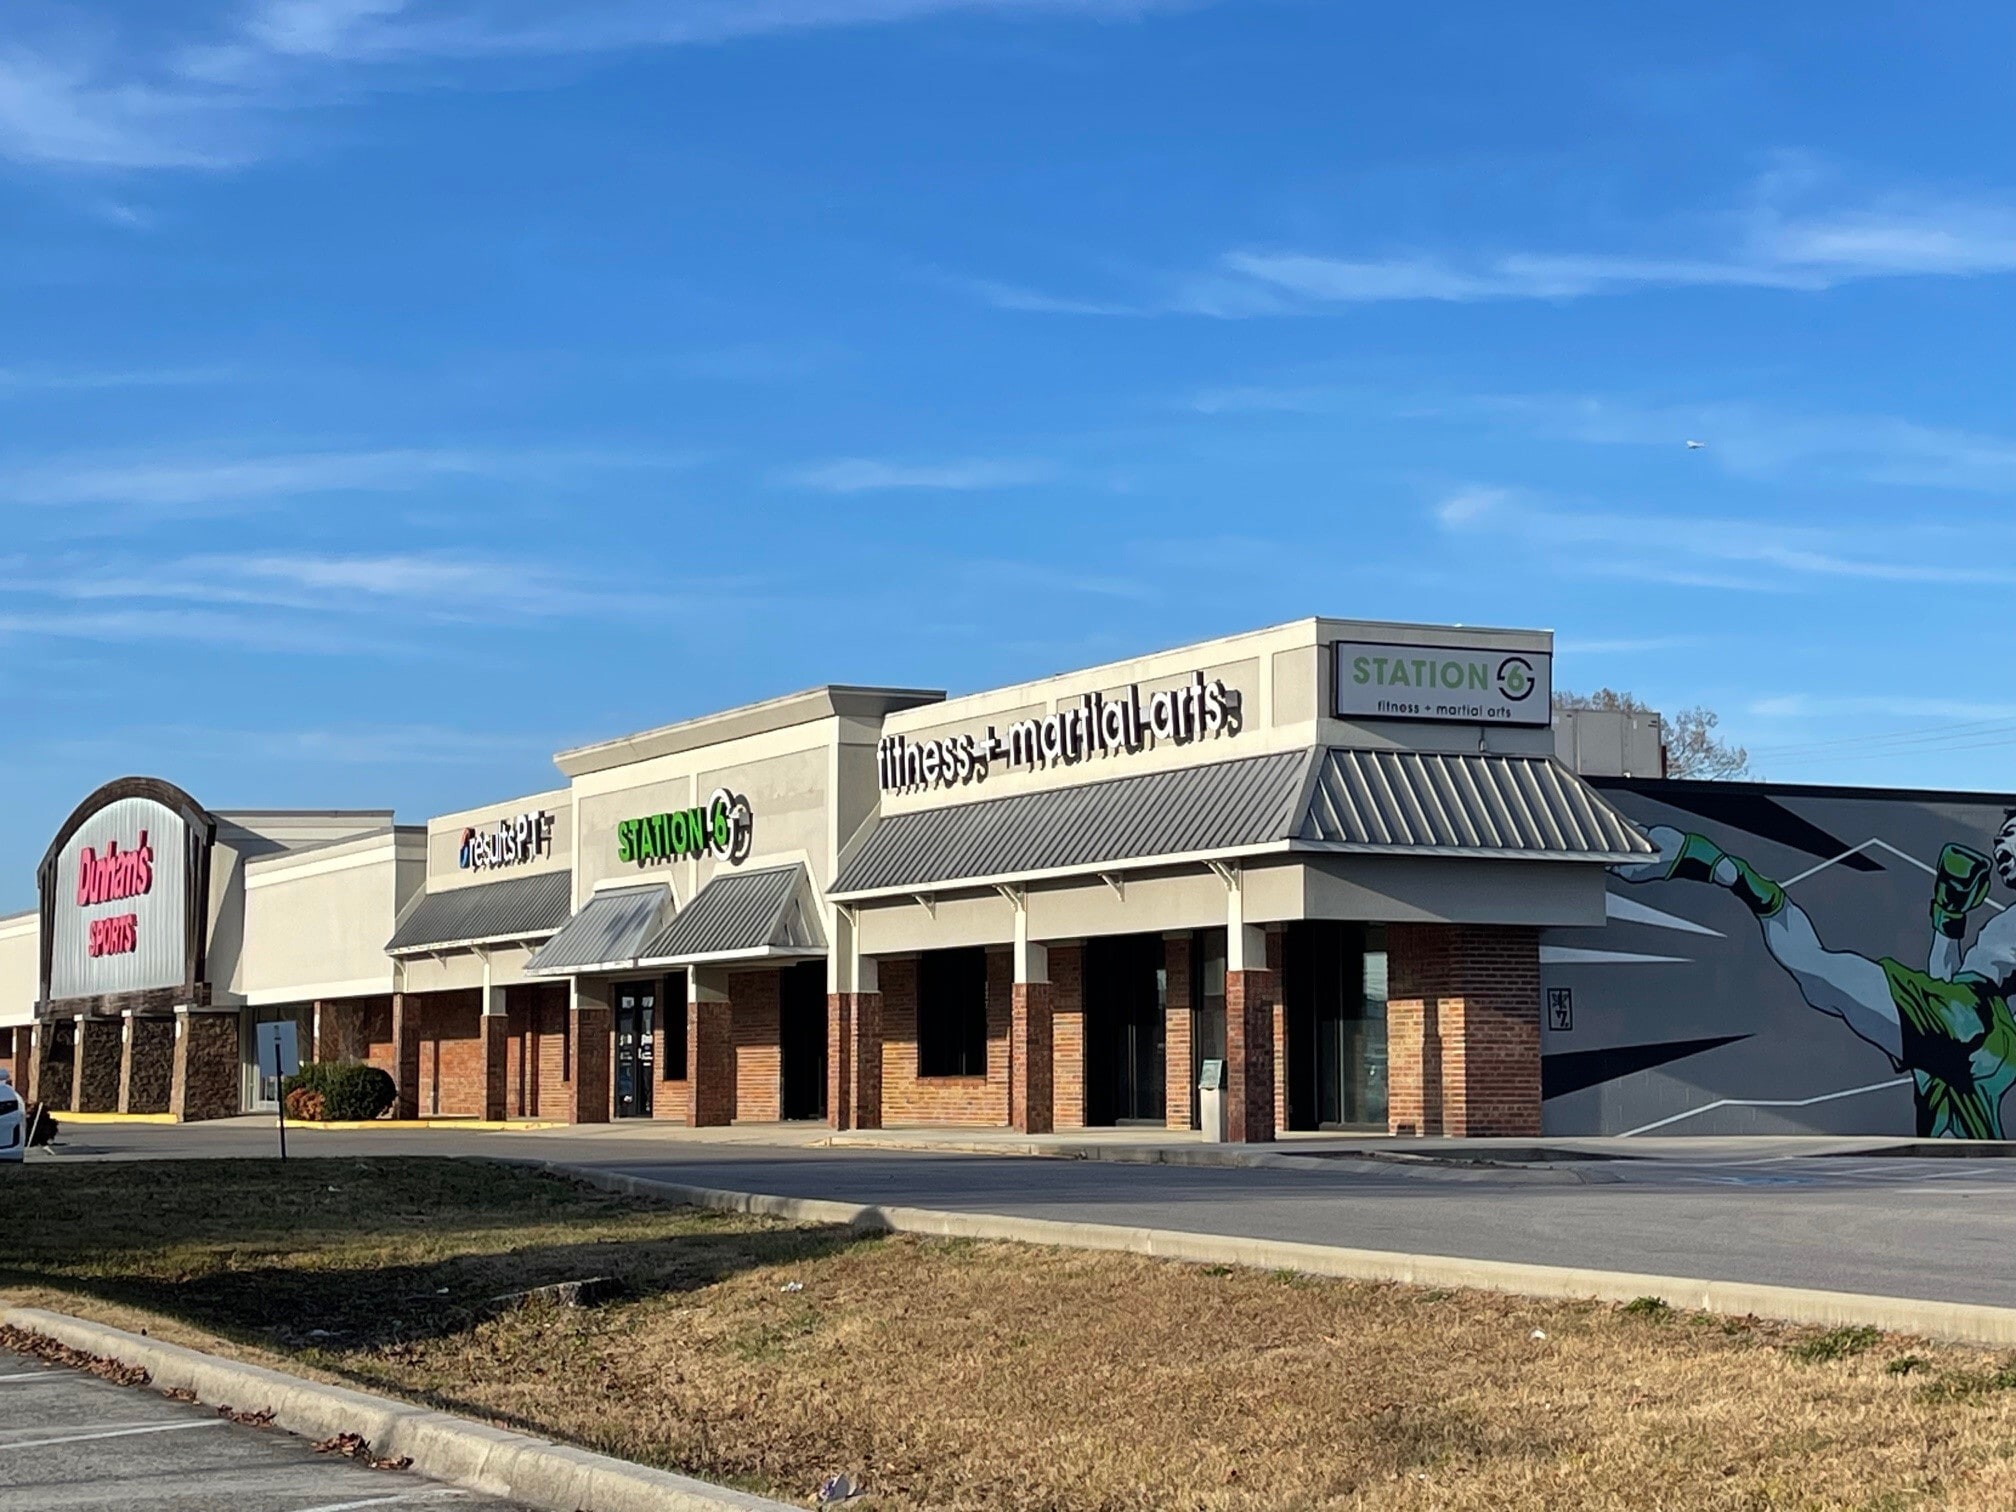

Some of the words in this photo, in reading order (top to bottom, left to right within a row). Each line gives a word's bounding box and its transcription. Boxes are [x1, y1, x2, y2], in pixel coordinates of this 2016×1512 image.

[1352, 656, 1488, 691] STATION
[1507, 665, 1525, 692] 6
[877, 734, 974, 790] fitness
[1009, 684, 1140, 766] martial
[1150, 670, 1228, 740] arts
[1377, 699, 1420, 715] fitness
[1436, 703, 1483, 718] martial
[1488, 705, 1512, 718] arts
[618, 806, 705, 863] STATION
[77, 829, 154, 907] Dunham's
[89, 913, 138, 958] SPORTS
